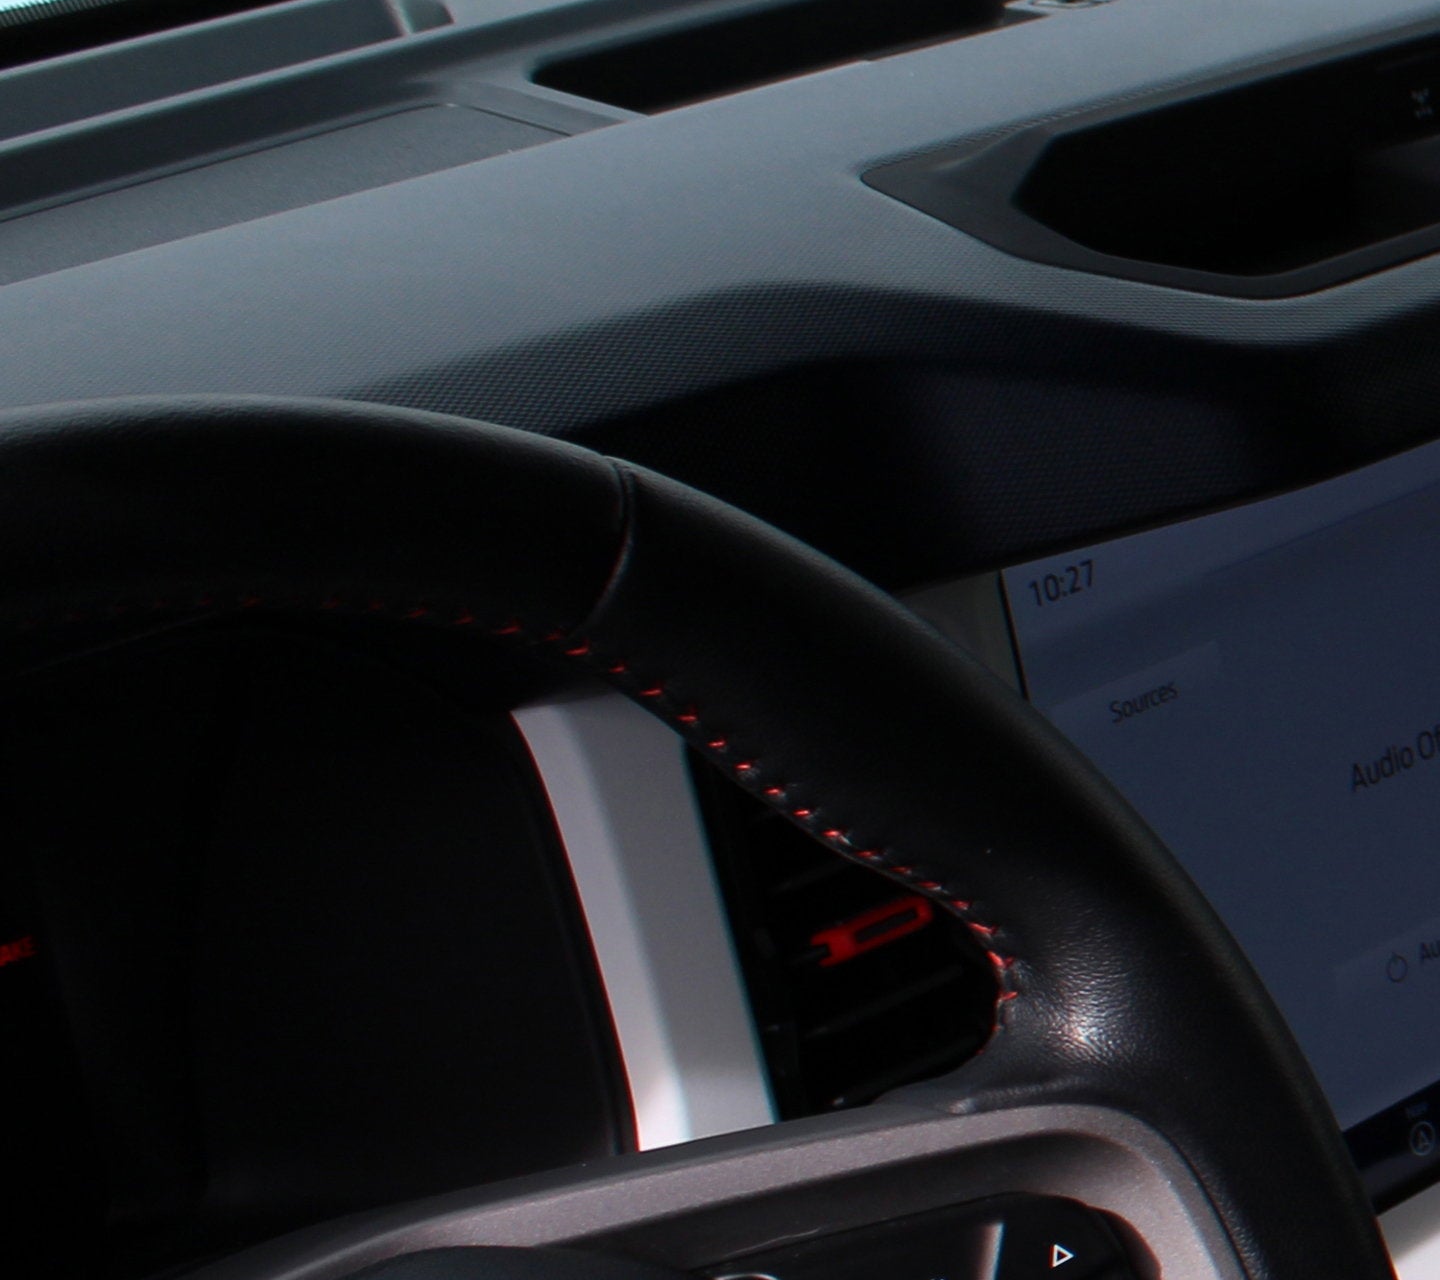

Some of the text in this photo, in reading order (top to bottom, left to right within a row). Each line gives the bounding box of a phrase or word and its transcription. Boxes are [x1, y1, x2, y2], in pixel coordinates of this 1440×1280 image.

[1029, 560, 1094, 607] 10:27
[1108, 682, 1179, 724] Sources
[1350, 744, 1415, 793] Audio
